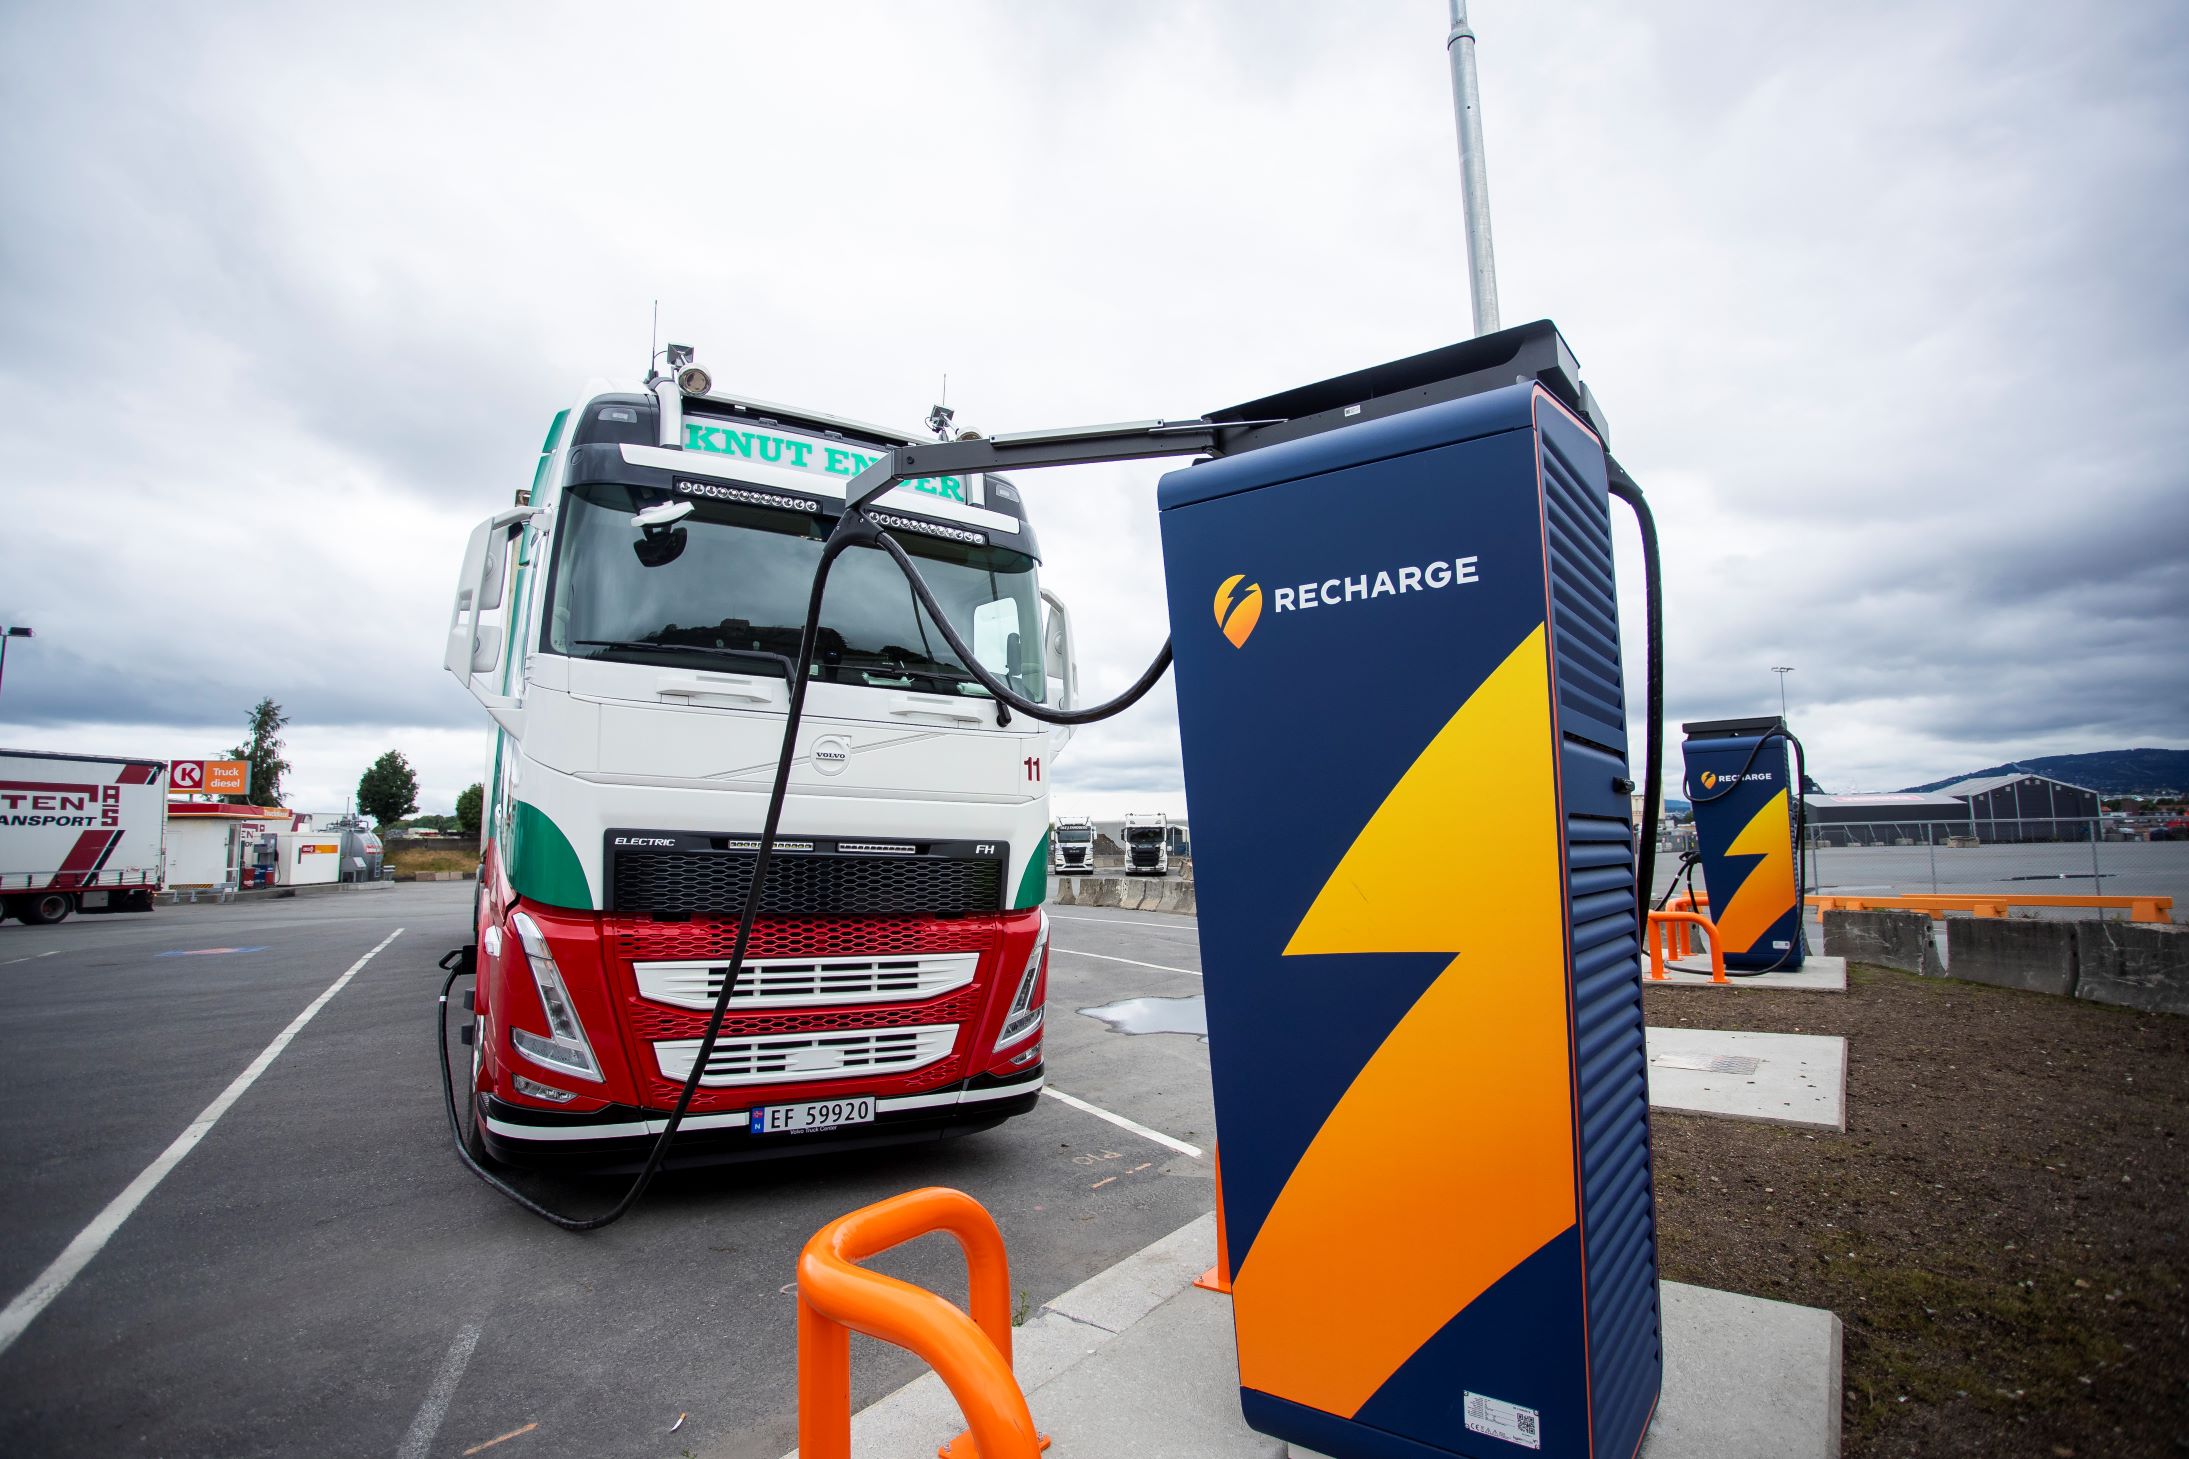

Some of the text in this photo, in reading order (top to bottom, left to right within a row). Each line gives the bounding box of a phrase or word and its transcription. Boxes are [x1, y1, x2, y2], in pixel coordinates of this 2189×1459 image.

[684, 423, 965, 502] KNUT ENER
[1274, 555, 1479, 613] RECHARGE
[212, 767, 239, 776] Truck
[1024, 756, 1041, 782] 11
[1718, 773, 1772, 782] RECARGE
[210, 778, 240, 788] diesel
[1, 794, 85, 811] TEN
[614, 837, 676, 846] ELECTRIC
[975, 844, 995, 854] FH
[771, 1101, 868, 1129] EF 59920
[805, 1126, 819, 1134] Truck
